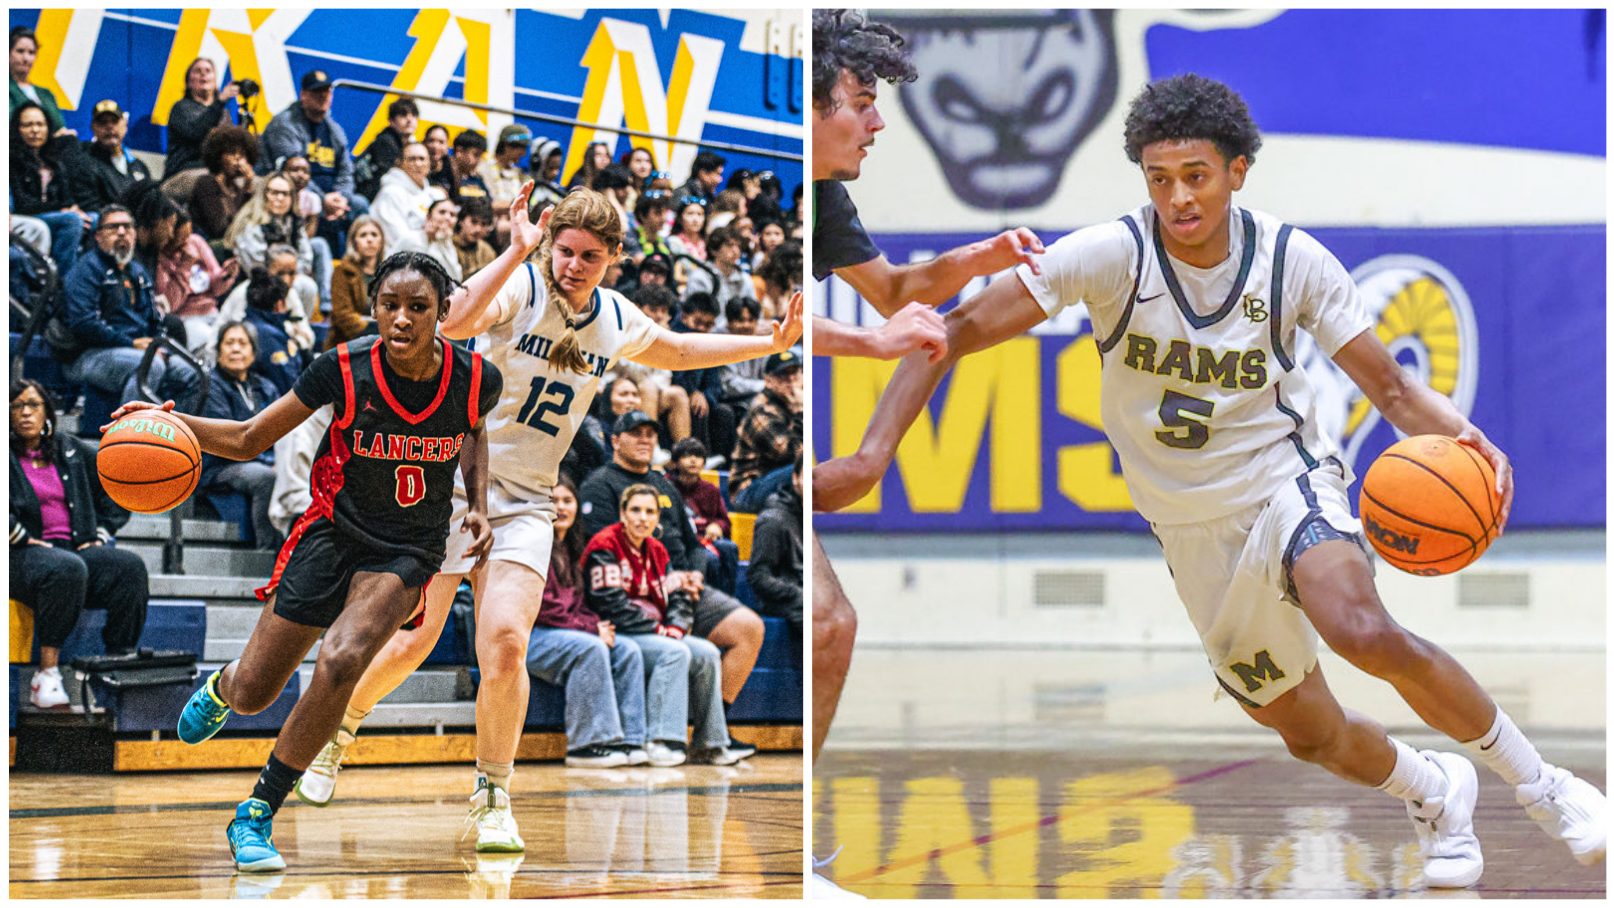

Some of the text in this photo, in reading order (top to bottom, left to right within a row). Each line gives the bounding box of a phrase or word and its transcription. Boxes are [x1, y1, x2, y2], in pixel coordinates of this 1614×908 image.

[1124, 332, 1268, 390] RAMS
[516, 376, 575, 438] 12
[1154, 388, 1215, 449] 5
[353, 429, 465, 462] LANCERS
[395, 464, 427, 507] 0
[1229, 648, 1287, 694] M
